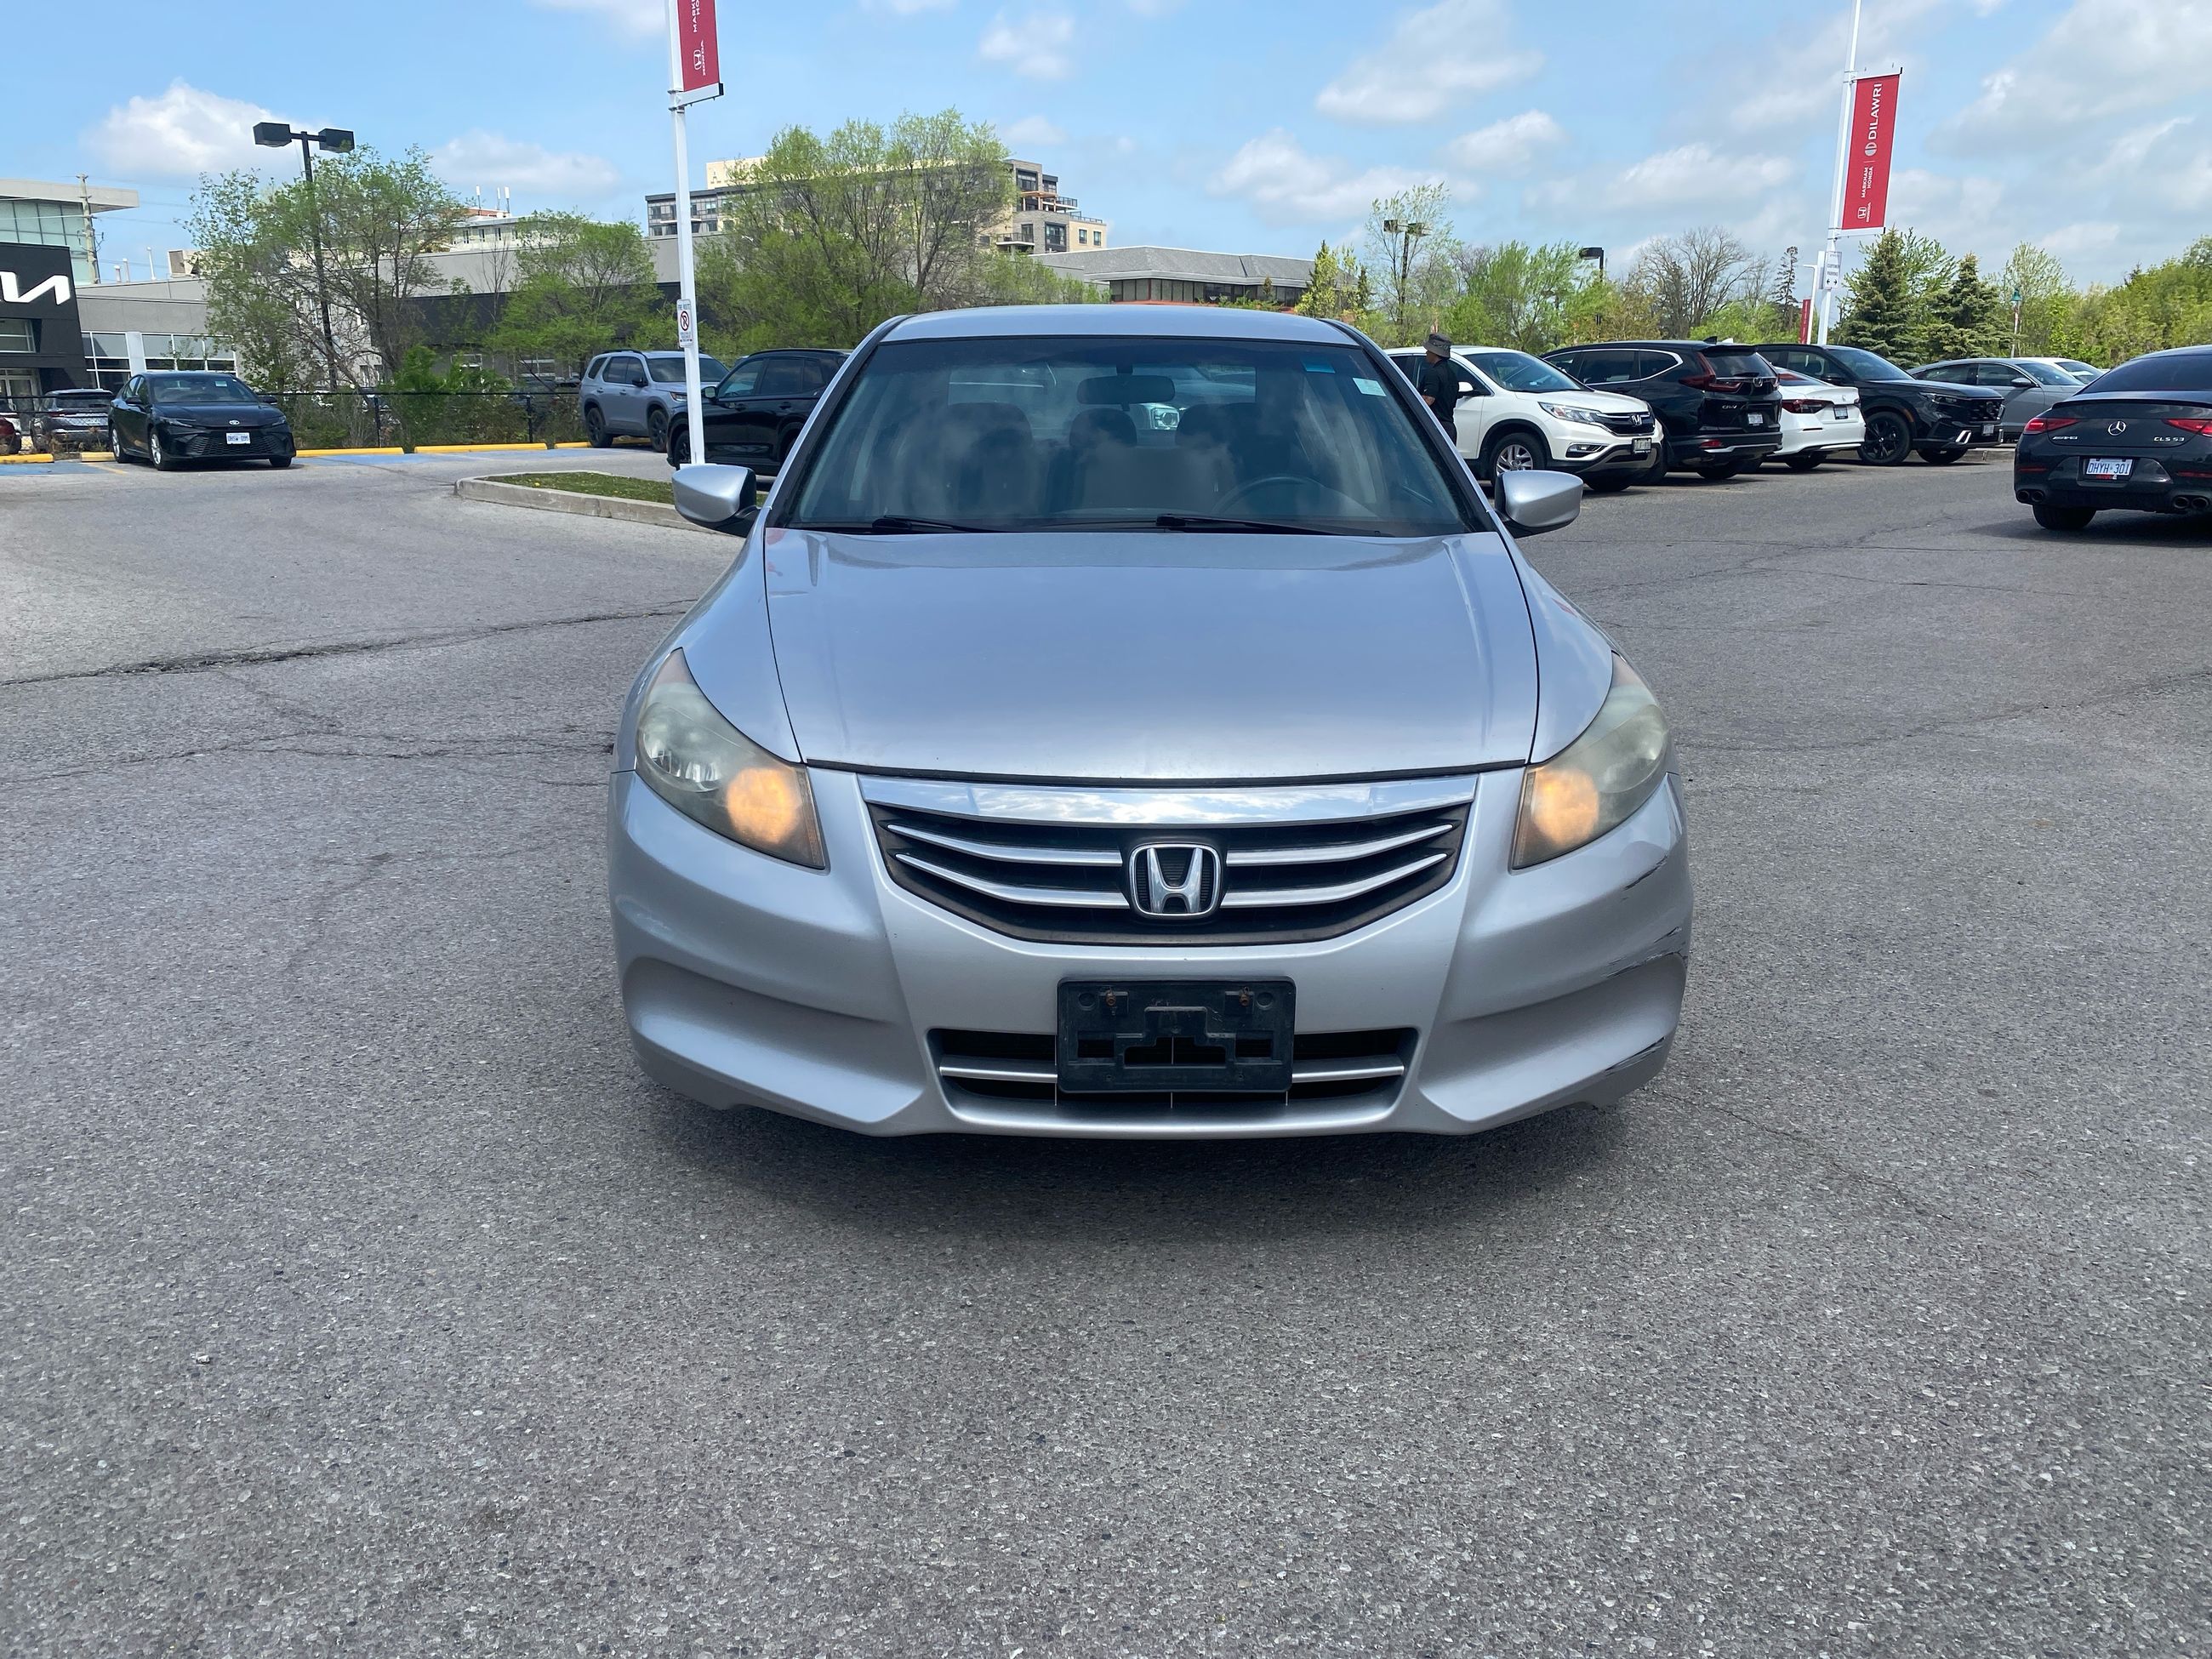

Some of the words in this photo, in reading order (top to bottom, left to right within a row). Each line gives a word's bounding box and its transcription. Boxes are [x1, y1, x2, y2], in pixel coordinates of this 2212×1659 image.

[1868, 83, 1883, 140] DILAWRI
[1861, 167, 1869, 198] MARKHAM
[2088, 462, 2110, 474] DHYH
[2113, 463, 2130, 474] 301
